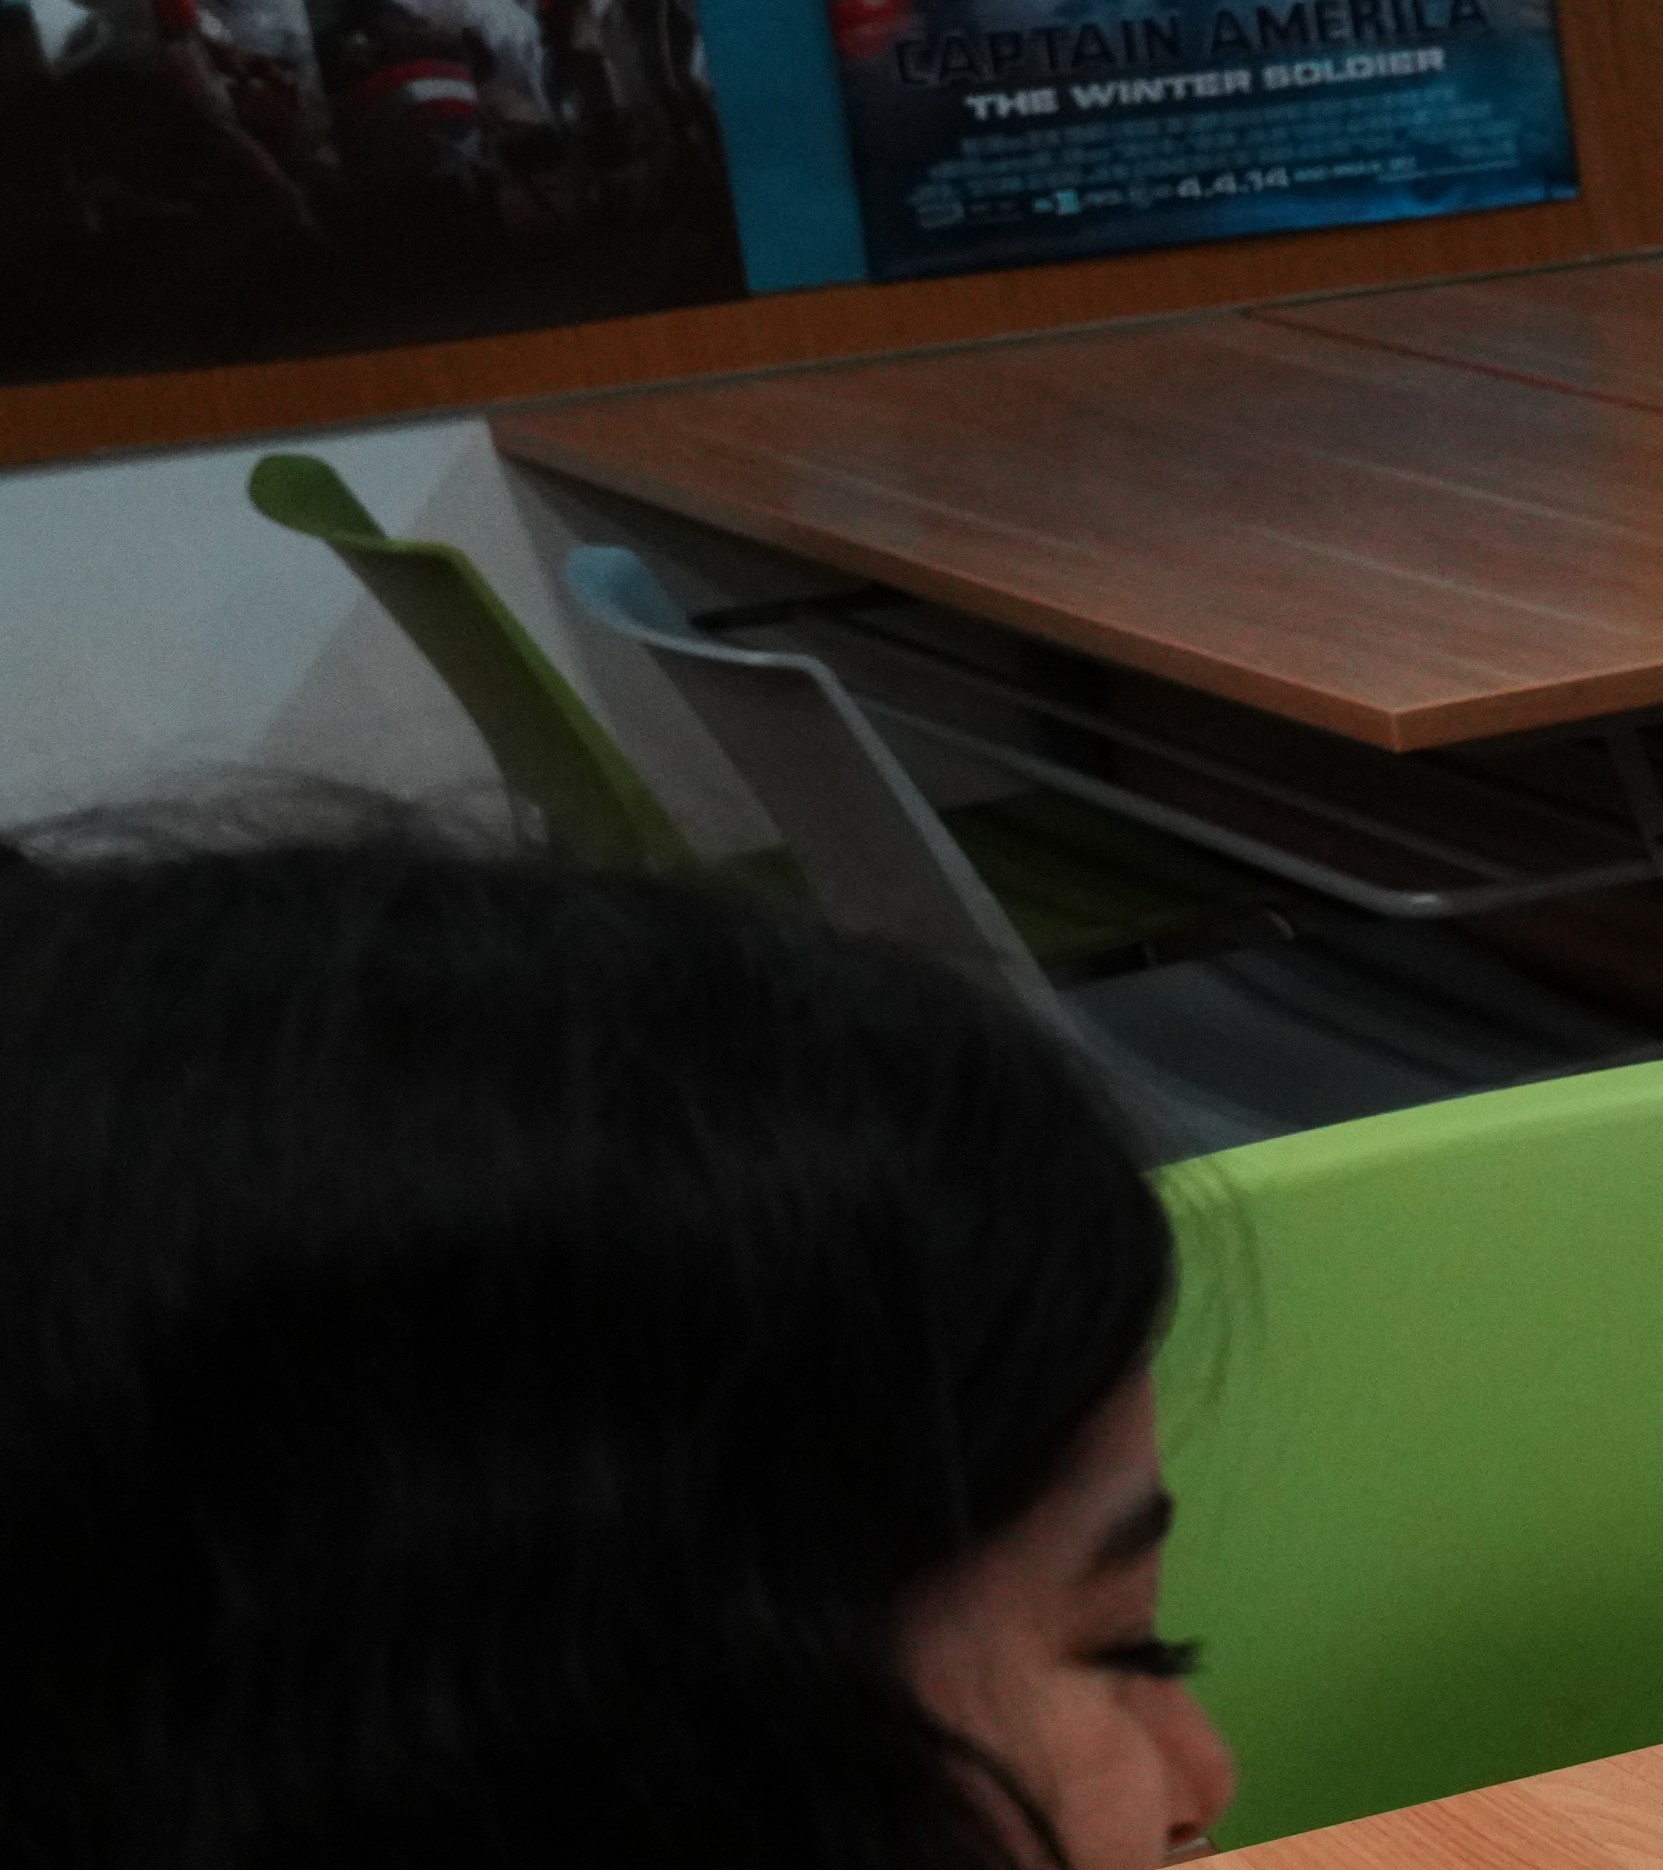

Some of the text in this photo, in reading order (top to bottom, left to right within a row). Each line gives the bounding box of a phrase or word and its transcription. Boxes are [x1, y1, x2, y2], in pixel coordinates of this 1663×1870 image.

[896, 16, 1182, 86] CAPTAIN
[965, 47, 1446, 120] THE WINTER SOLDIER
[1176, 167, 1290, 198] 4.4.14
